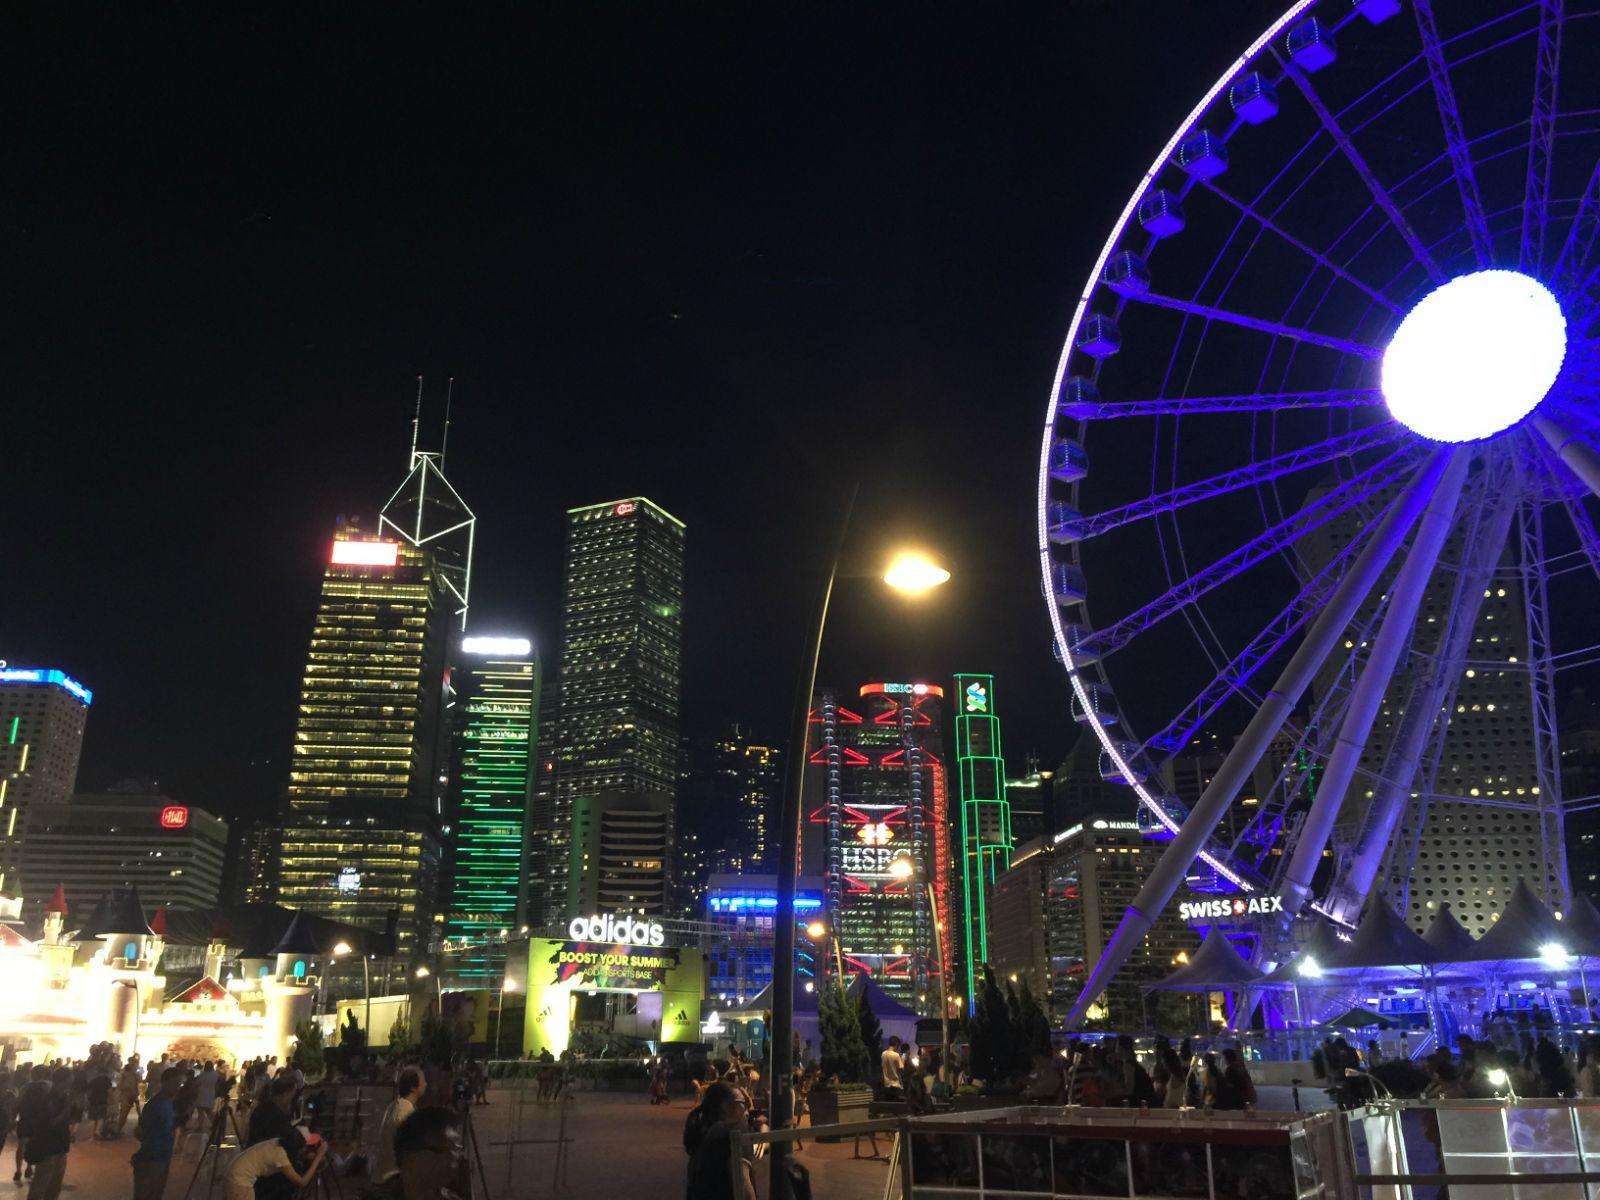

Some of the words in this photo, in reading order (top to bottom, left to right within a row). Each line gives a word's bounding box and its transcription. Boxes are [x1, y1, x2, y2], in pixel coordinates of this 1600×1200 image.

[1179, 900, 1233, 920] SWISS
[1247, 896, 1283, 914] AEX
[569, 913, 665, 946] adidas
[559, 952, 598, 964] BOOST
[600, 954, 629, 966] YOUR
[630, 956, 676, 969] SUMMER
[635, 970, 653, 979] BASE
